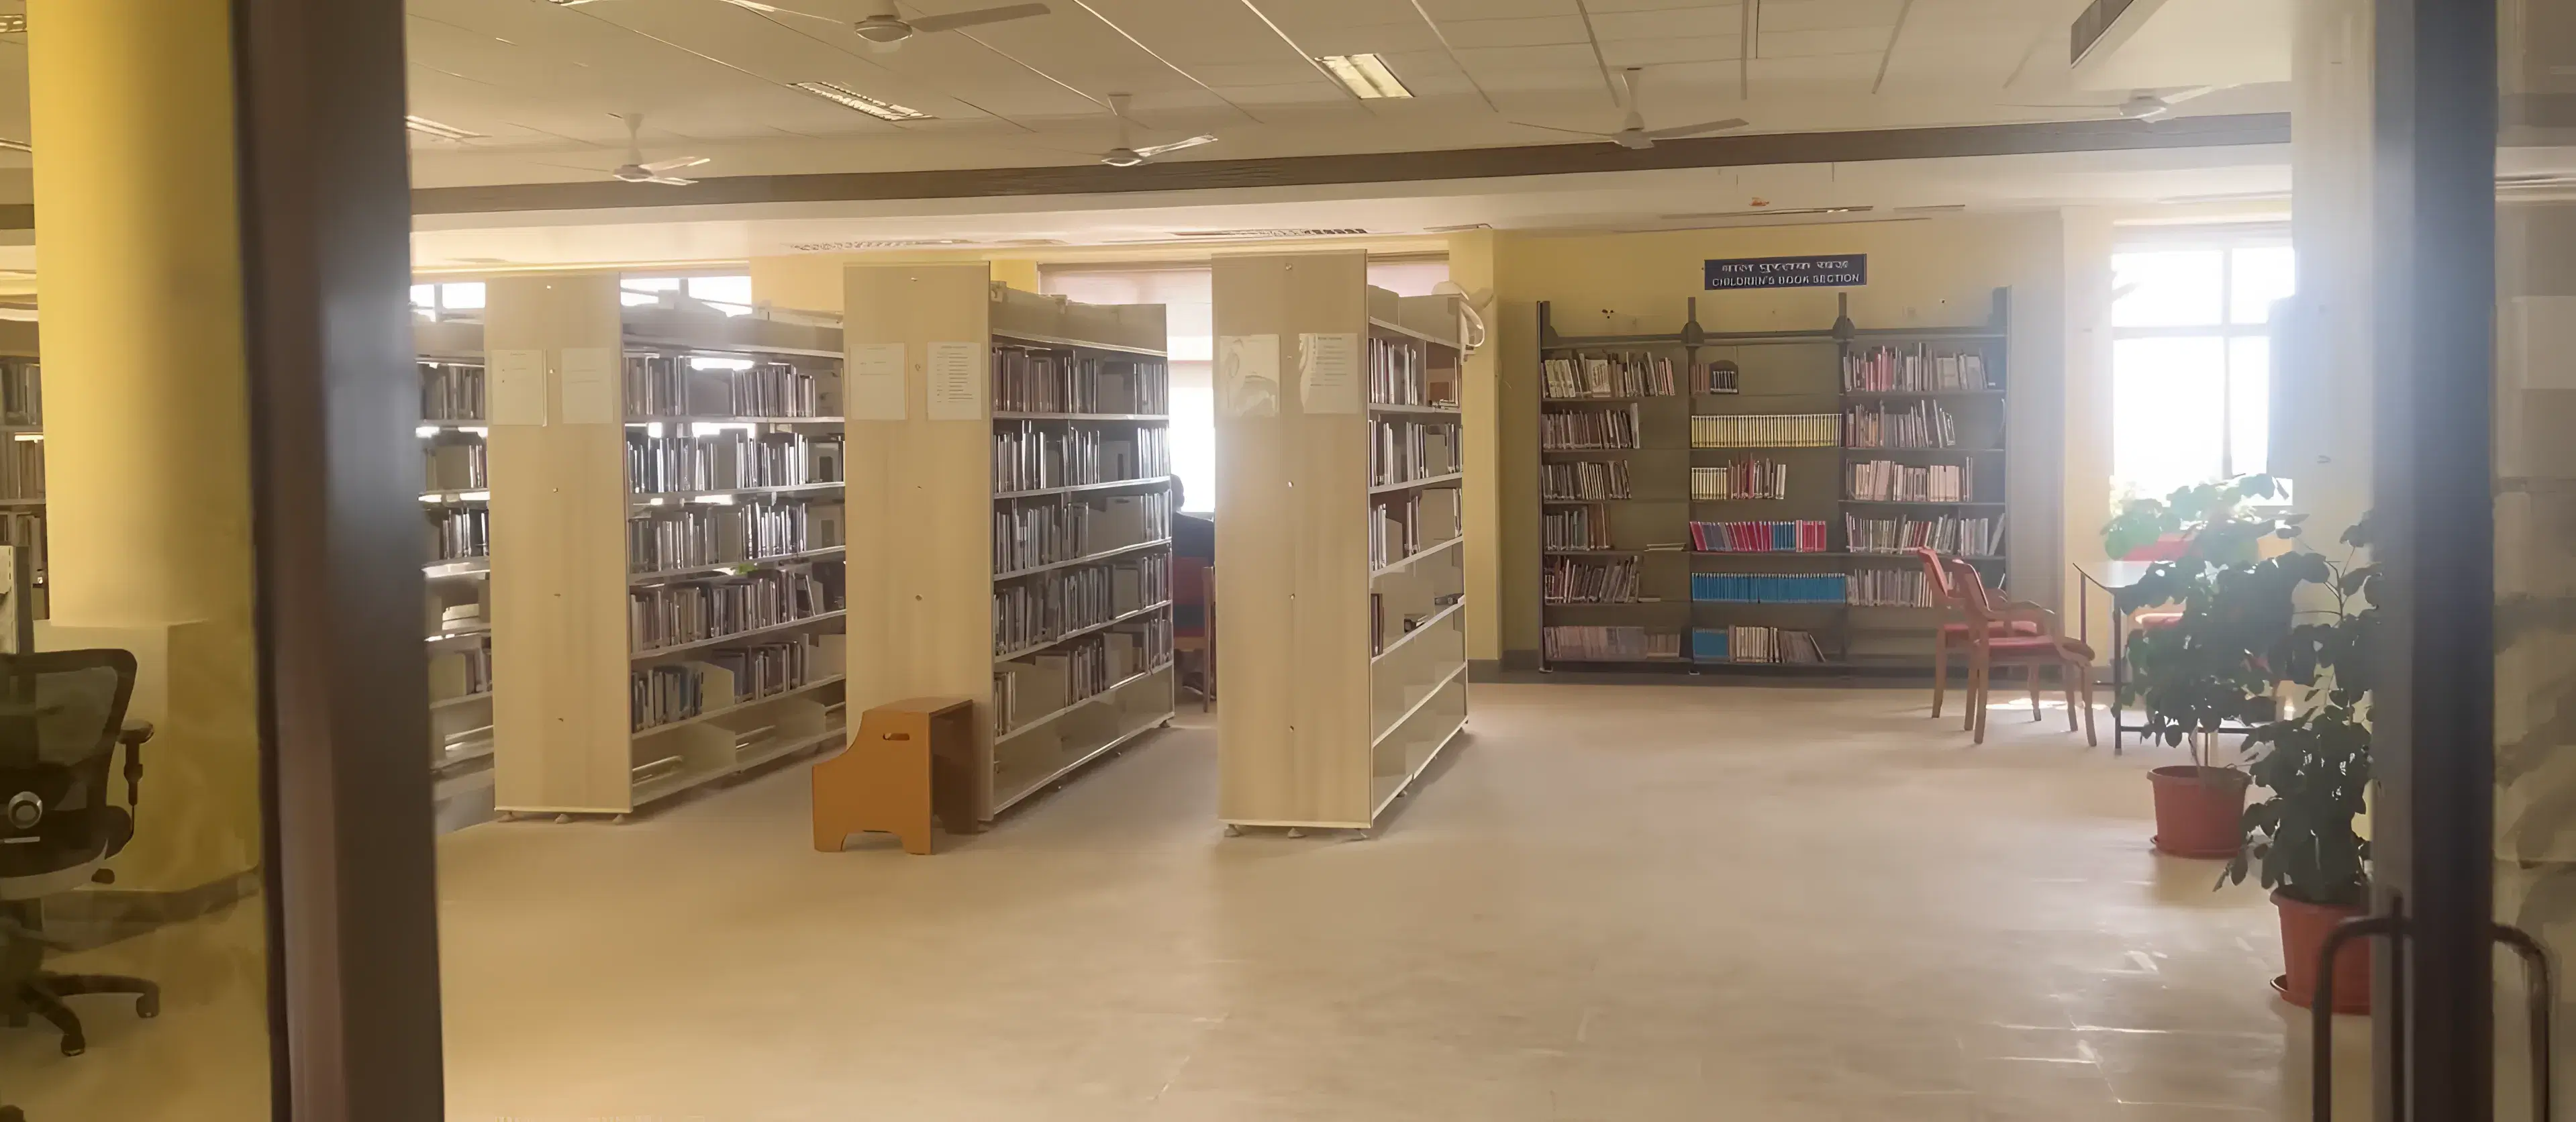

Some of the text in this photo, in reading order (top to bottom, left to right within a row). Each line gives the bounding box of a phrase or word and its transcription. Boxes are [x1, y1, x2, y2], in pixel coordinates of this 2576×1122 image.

[1712, 274, 1859, 287] CHILDREN'S BOOK SECTION
